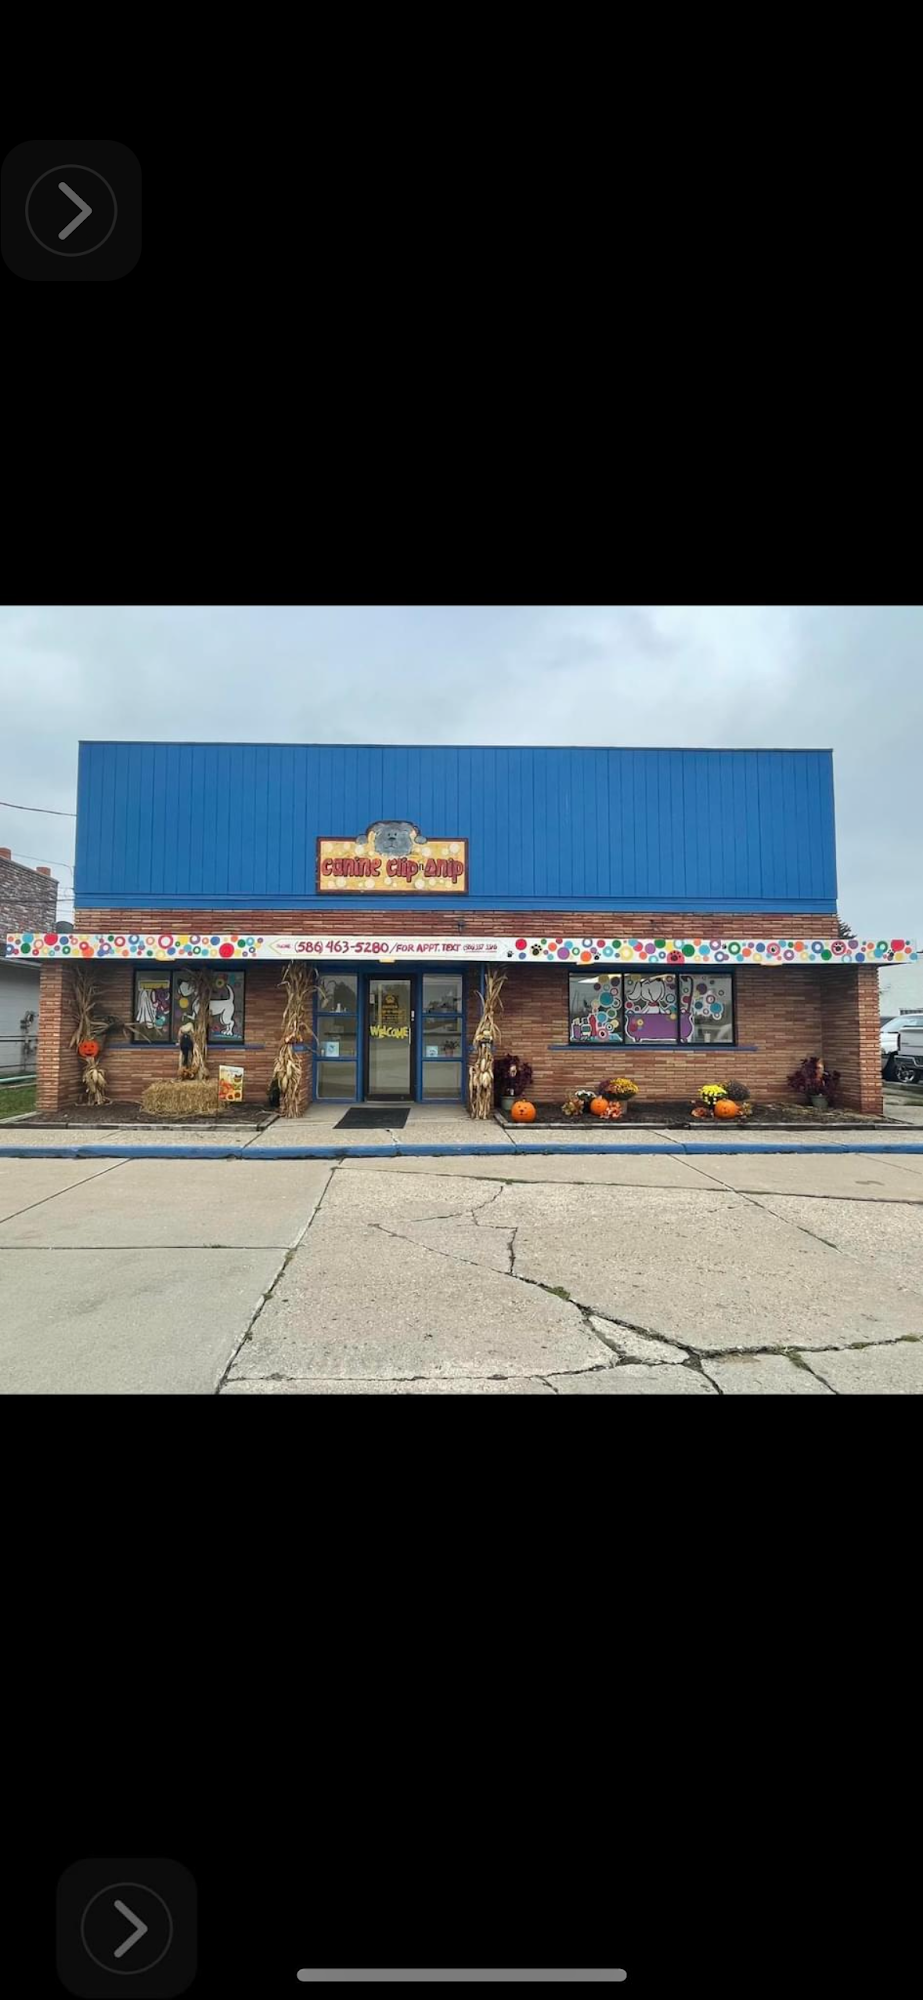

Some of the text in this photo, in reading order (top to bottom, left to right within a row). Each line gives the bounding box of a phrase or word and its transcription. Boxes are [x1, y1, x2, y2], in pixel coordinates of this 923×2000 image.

[294, 941, 323, 954] (586)
[442, 943, 461, 952] TEXT
[370, 1025, 409, 1039] WELCOME
